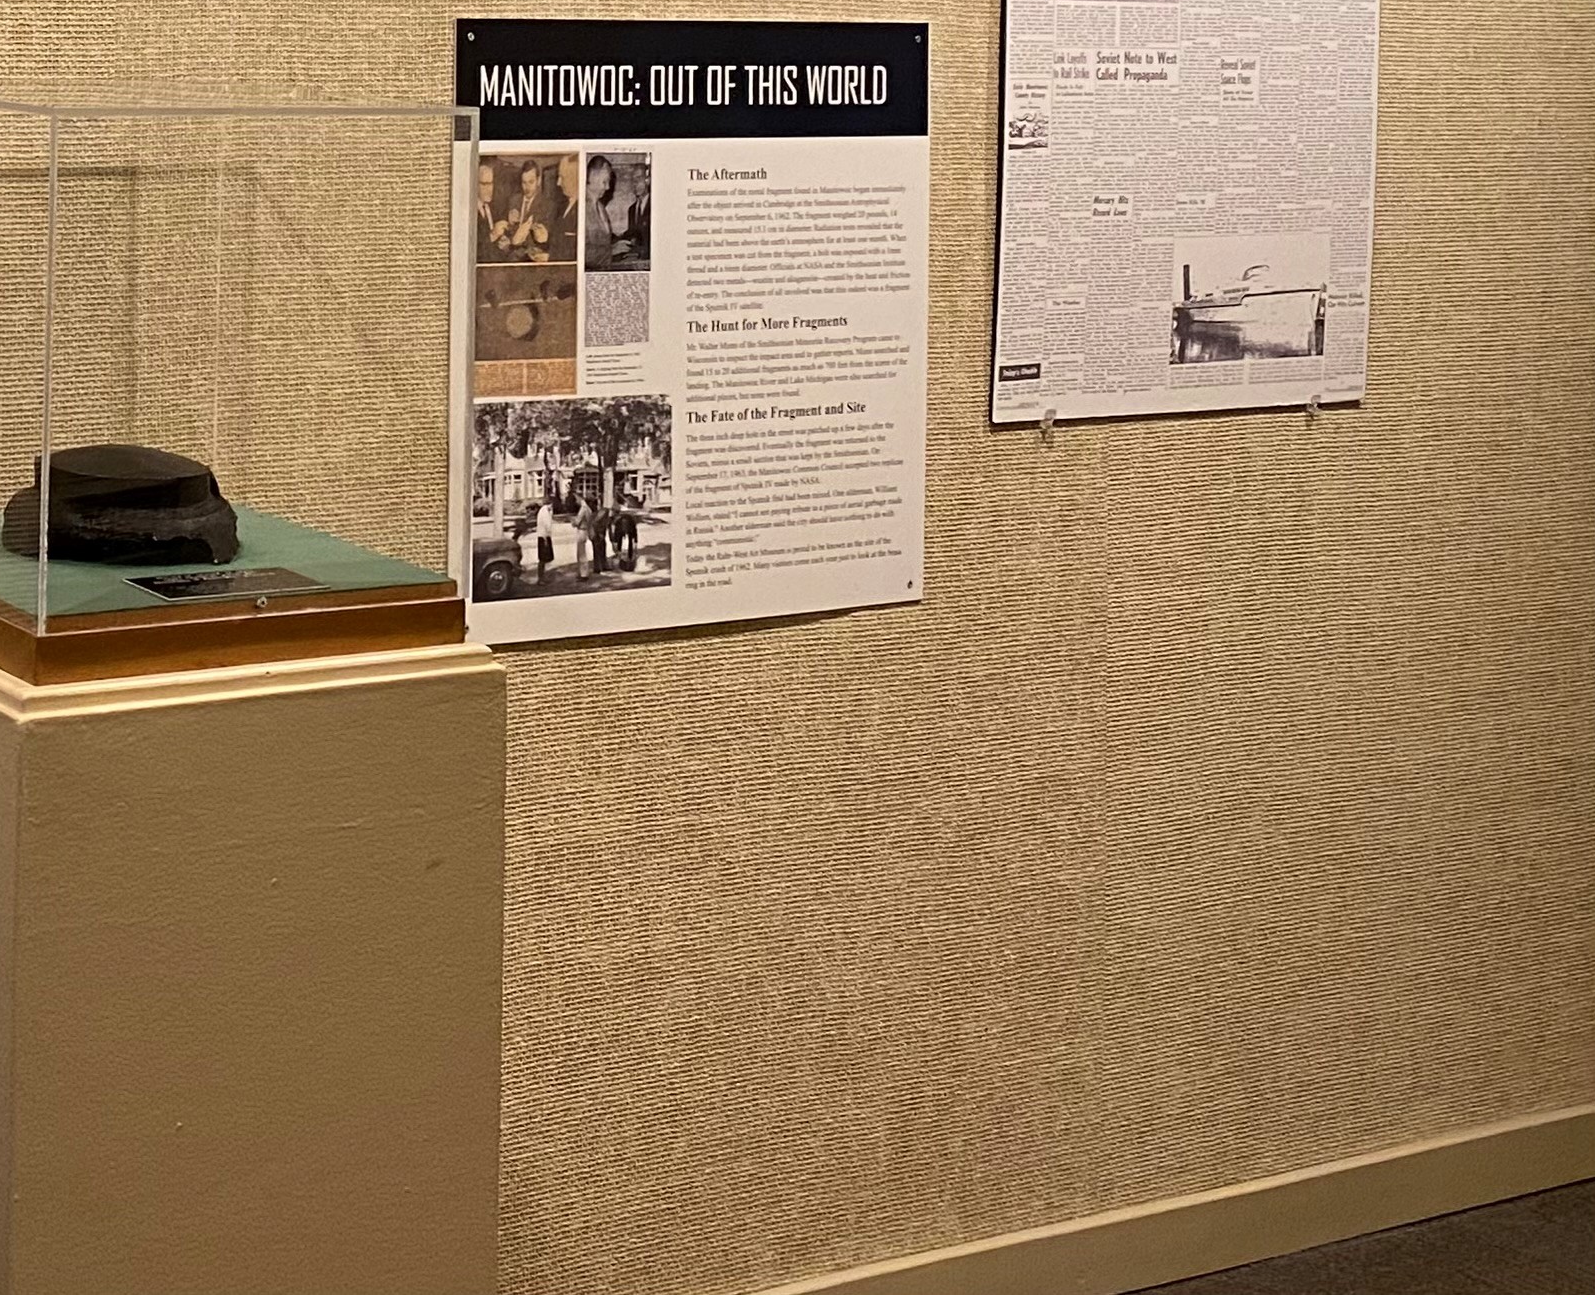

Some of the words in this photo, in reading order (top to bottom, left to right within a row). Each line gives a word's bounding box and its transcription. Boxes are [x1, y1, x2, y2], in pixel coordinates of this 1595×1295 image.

[1096, 52, 1120, 64] Soviet
[1124, 52, 1142, 65] Note
[1146, 52, 1154, 65] to
[1157, 52, 1177, 65] West
[1096, 68, 1118, 81] Called
[1124, 68, 1168, 83] Propaganda
[480, 65, 640, 107] MANITOWOC:
[650, 65, 705, 106] OUT
[707, 65, 736, 106] OF
[744, 65, 798, 105] THIS
[805, 65, 887, 105] WORLD
[687, 168, 709, 180] The
[712, 168, 767, 180] Aftermath
[686, 320, 708, 333] The
[711, 320, 739, 332] Hunt
[741, 318, 758, 331] for
[761, 317, 789, 329] More
[792, 316, 847, 330] Fragments
[685, 411, 707, 423] The
[711, 410, 734, 422] Fate
[736, 408, 749, 420] of
[750, 407, 767, 419] the
[770, 405, 821, 420] Fragment
[824, 402, 843, 415] and
[846, 401, 866, 413] Site
